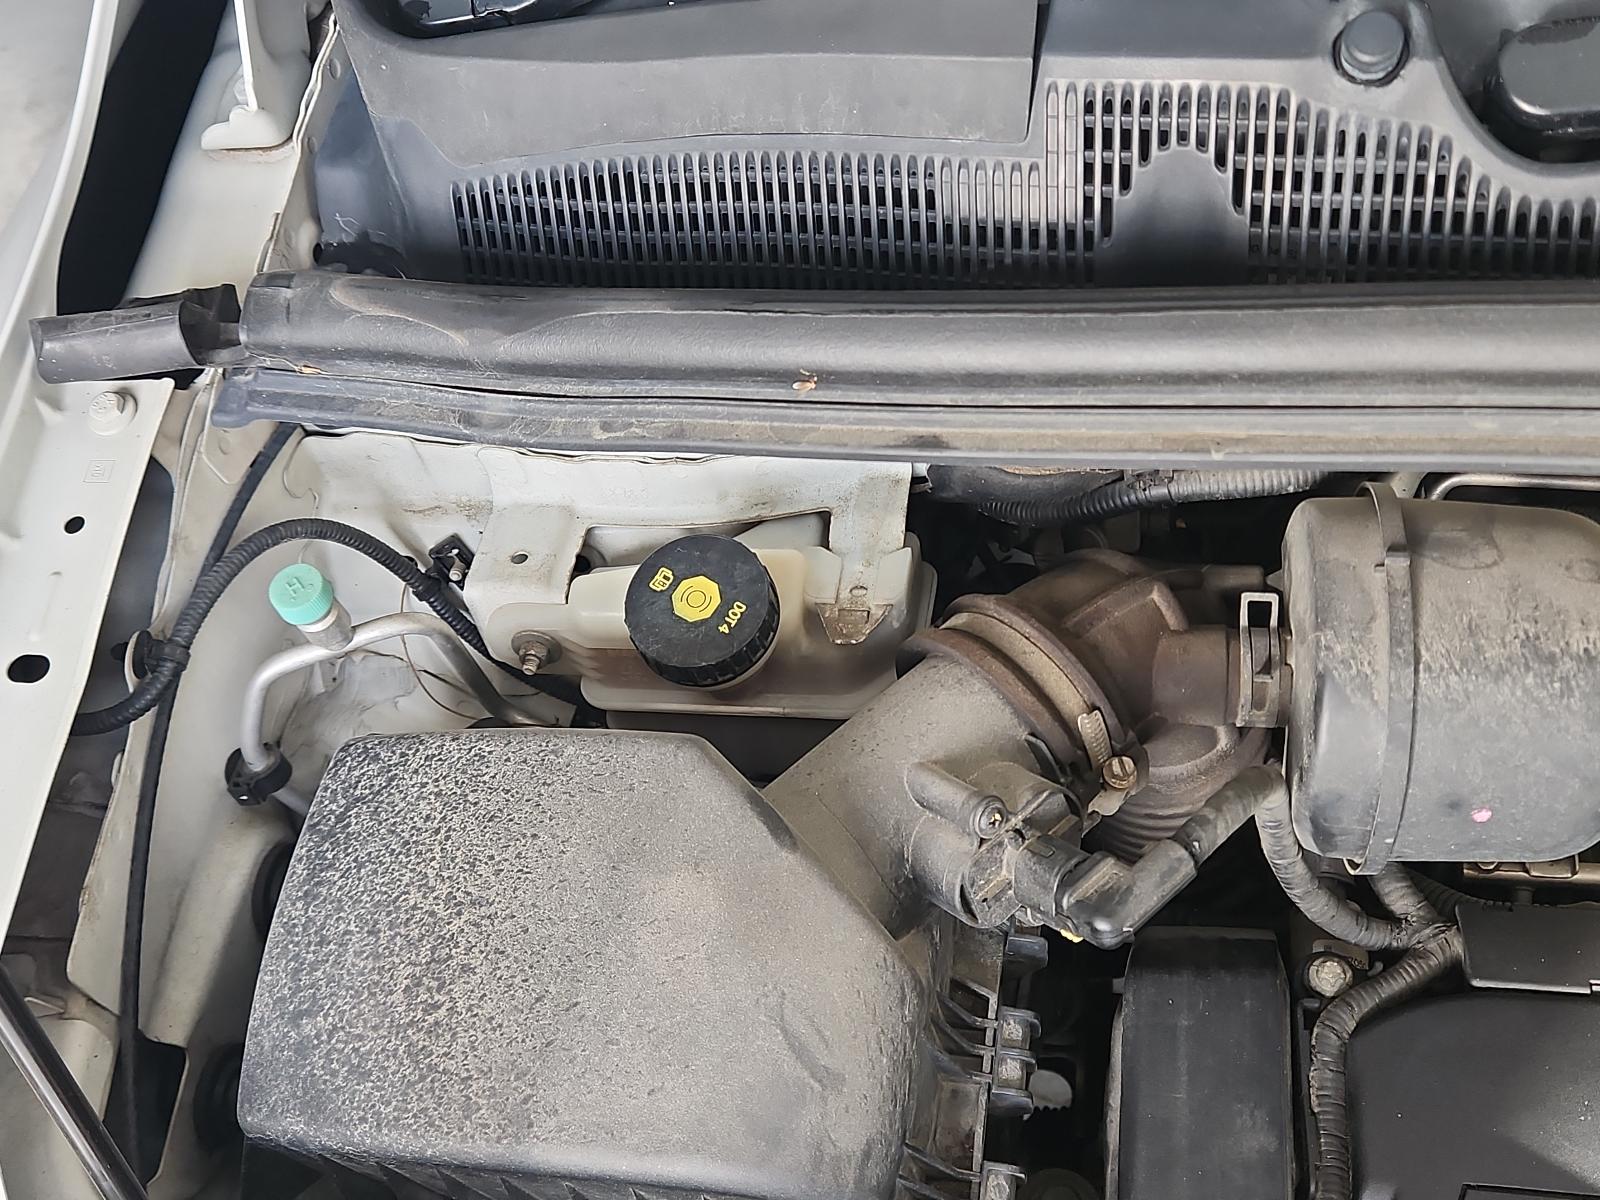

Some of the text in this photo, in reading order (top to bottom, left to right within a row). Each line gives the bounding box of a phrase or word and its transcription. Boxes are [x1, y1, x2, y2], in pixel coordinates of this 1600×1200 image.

[285, 576, 305, 597] H
[718, 601, 747, 634] DOT 4
